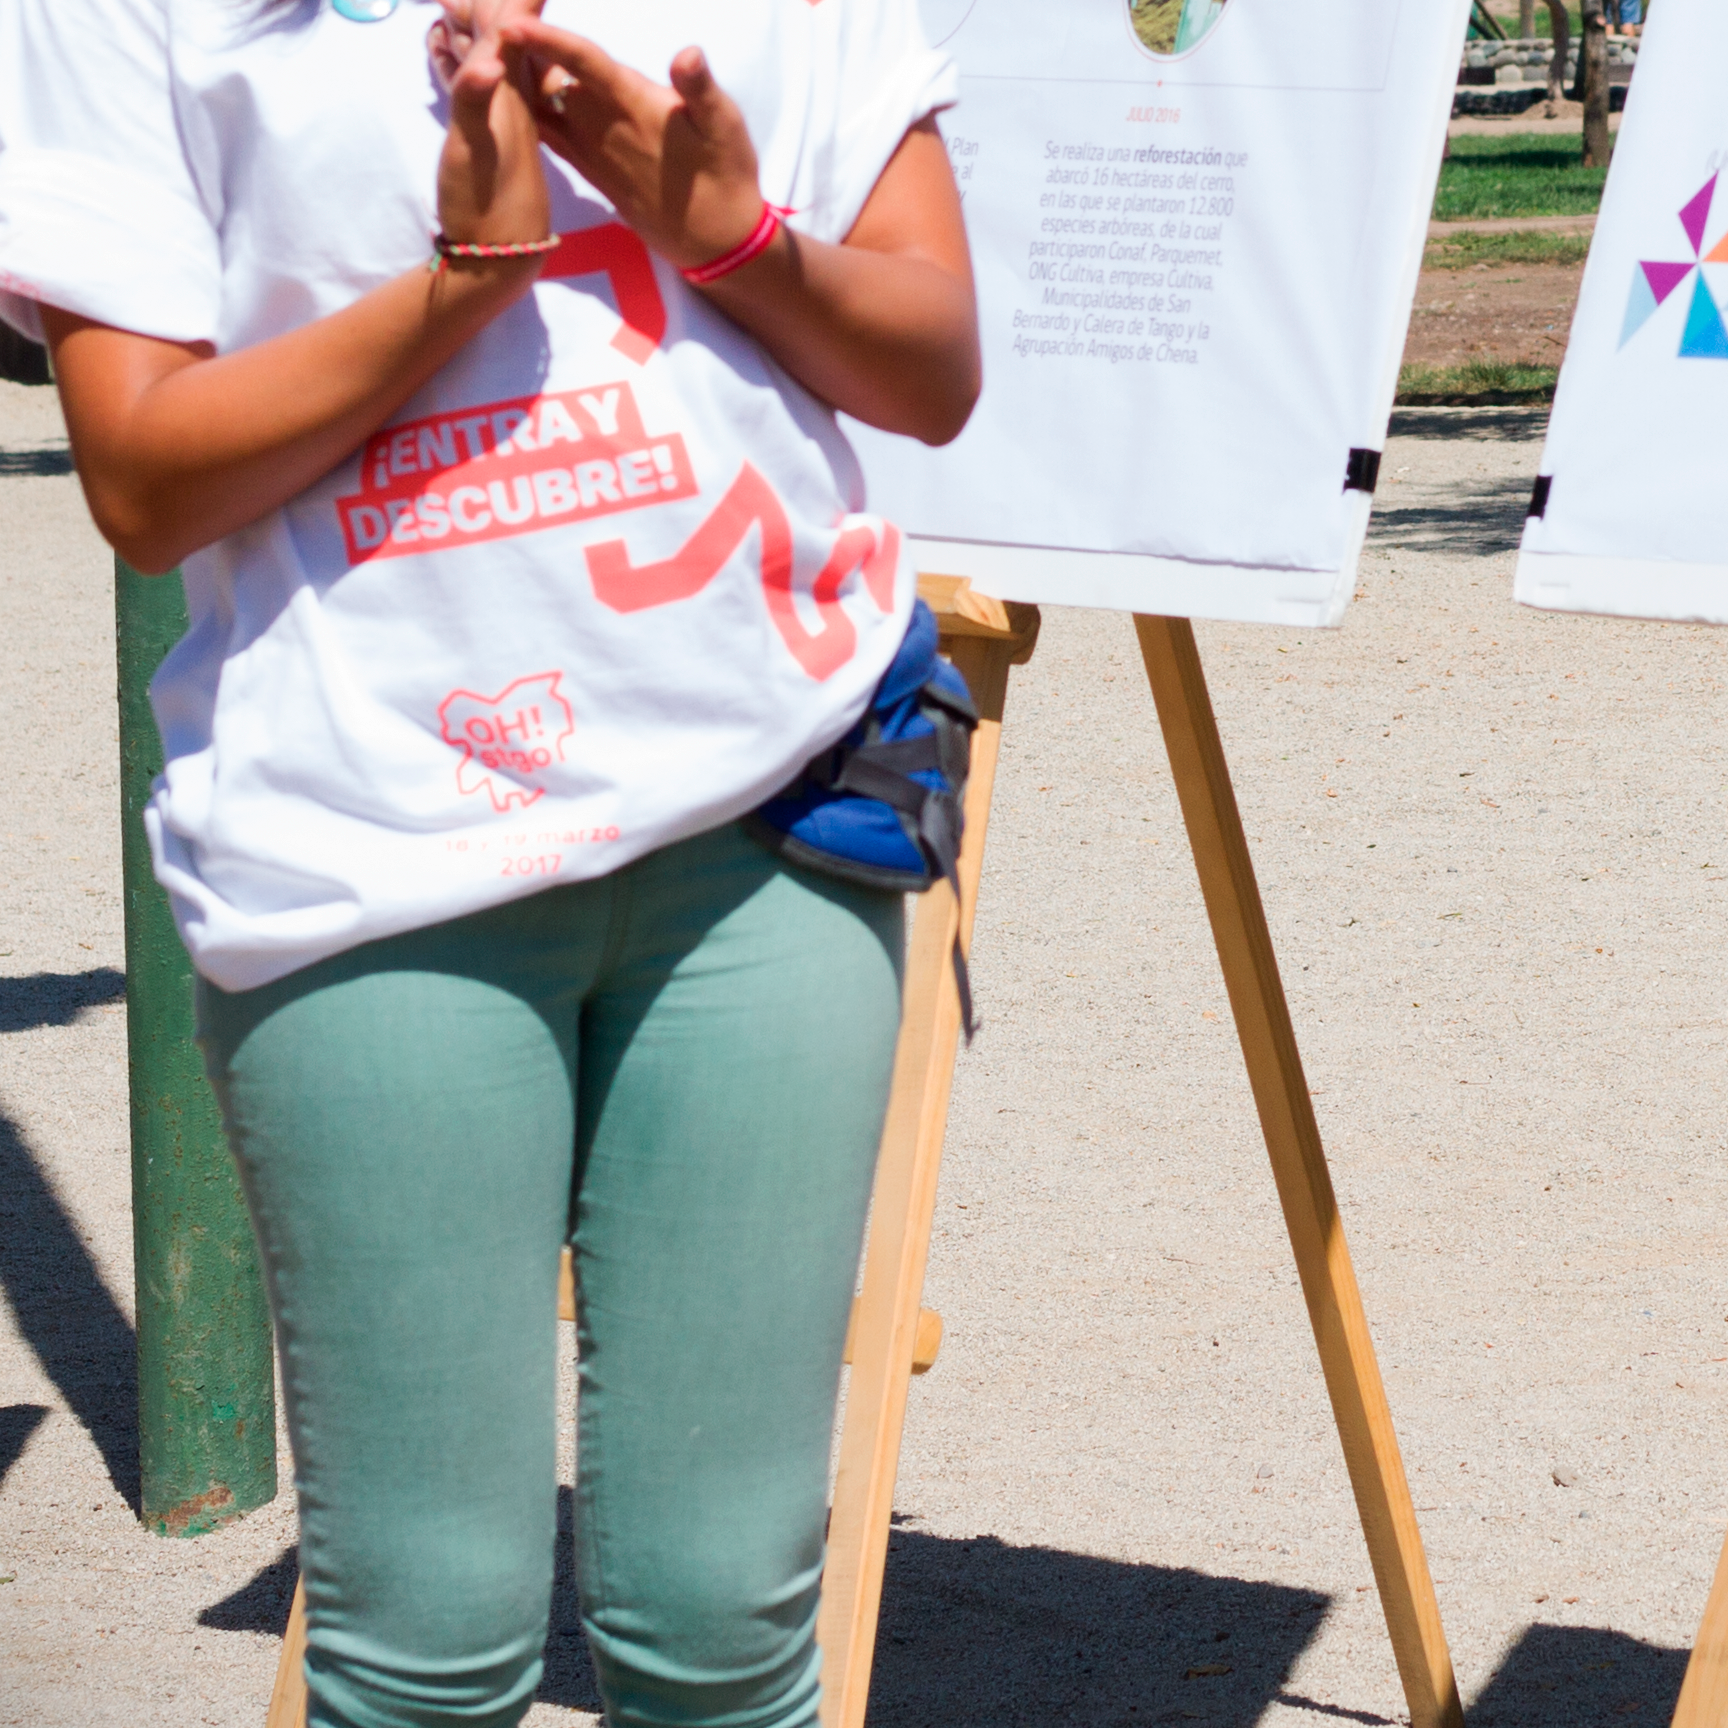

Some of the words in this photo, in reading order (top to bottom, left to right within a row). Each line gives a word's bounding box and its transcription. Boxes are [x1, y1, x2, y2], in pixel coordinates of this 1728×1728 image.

[1044, 140, 1060, 160] Se
[1062, 142, 1104, 162] realiza
[1107, 147, 1131, 163] una
[1133, 145, 1222, 166] reforestación
[1224, 150, 1249, 171] que
[1046, 166, 1088, 186] abarcó
[1092, 167, 1109, 186] 16
[1111, 168, 1174, 190] hectáreas
[1177, 171, 1198, 191] del
[1040, 193, 1055, 208] en
[1058, 190, 1076, 210] las
[1079, 194, 1104, 213] que
[1106, 196, 1121, 212] se
[1122, 193, 1185, 215] plantaron
[1188, 196, 1234, 217] 12.800
[1041, 215, 1095, 236] especies
[1159, 219, 1176, 239] de
[1179, 220, 1192, 240] la
[1194, 222, 1222, 241] cual
[1028, 239, 1105, 261] participaron
[1029, 262, 1058, 281] ONG
[1109, 269, 1164, 290] empresa
[347, 443, 678, 552] DESCUBRE!
[464, 705, 544, 745] OH!
[500, 853, 563, 877] 2017
